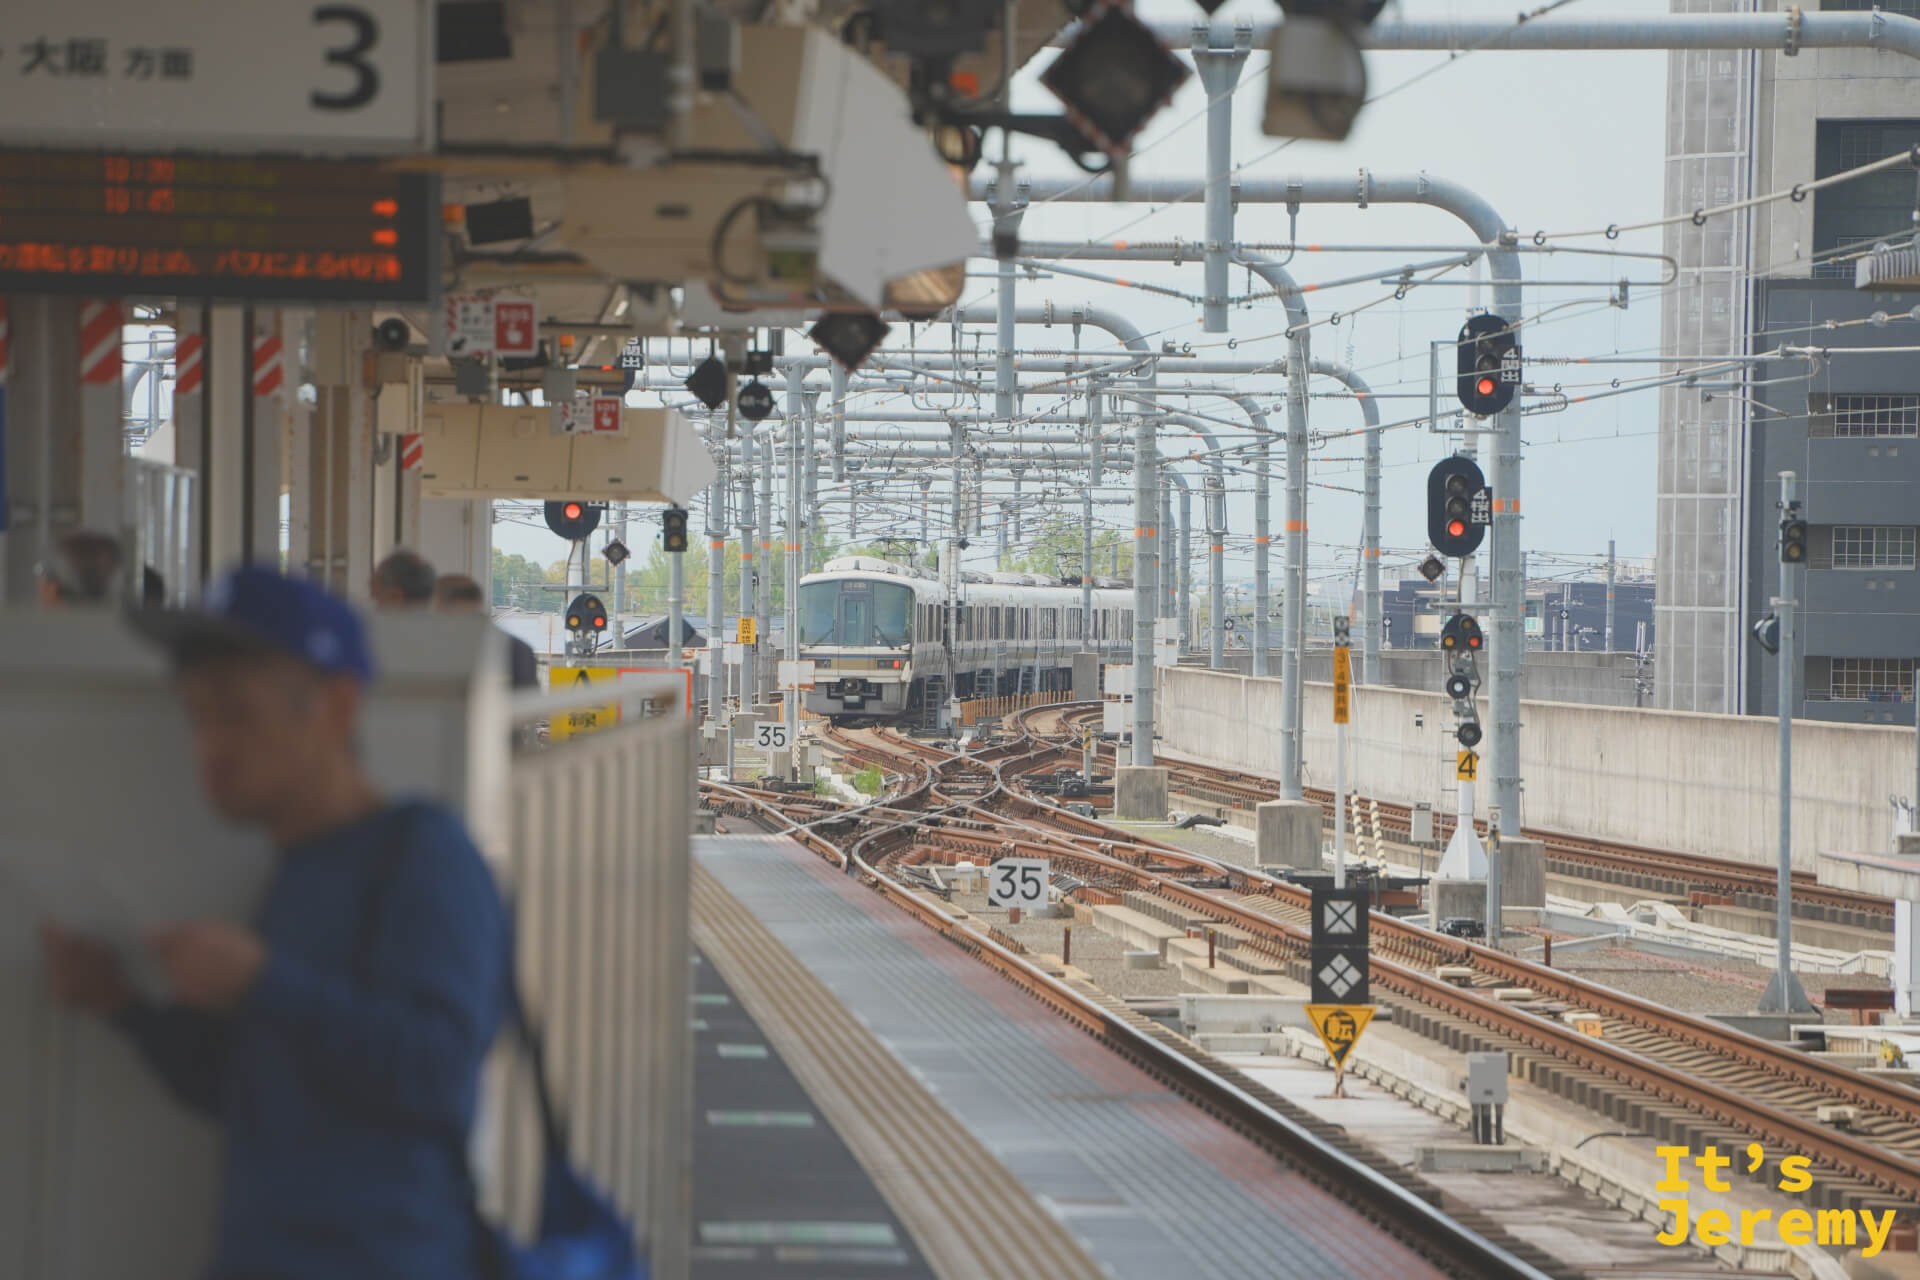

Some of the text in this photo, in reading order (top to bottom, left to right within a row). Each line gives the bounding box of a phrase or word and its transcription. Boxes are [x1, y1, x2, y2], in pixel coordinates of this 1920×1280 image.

[20, 36, 108, 77] 大阪
[308, 3, 382, 112] 3
[758, 725, 786, 748] 35
[1458, 753, 1477, 778] 4
[996, 864, 1042, 900] 35
